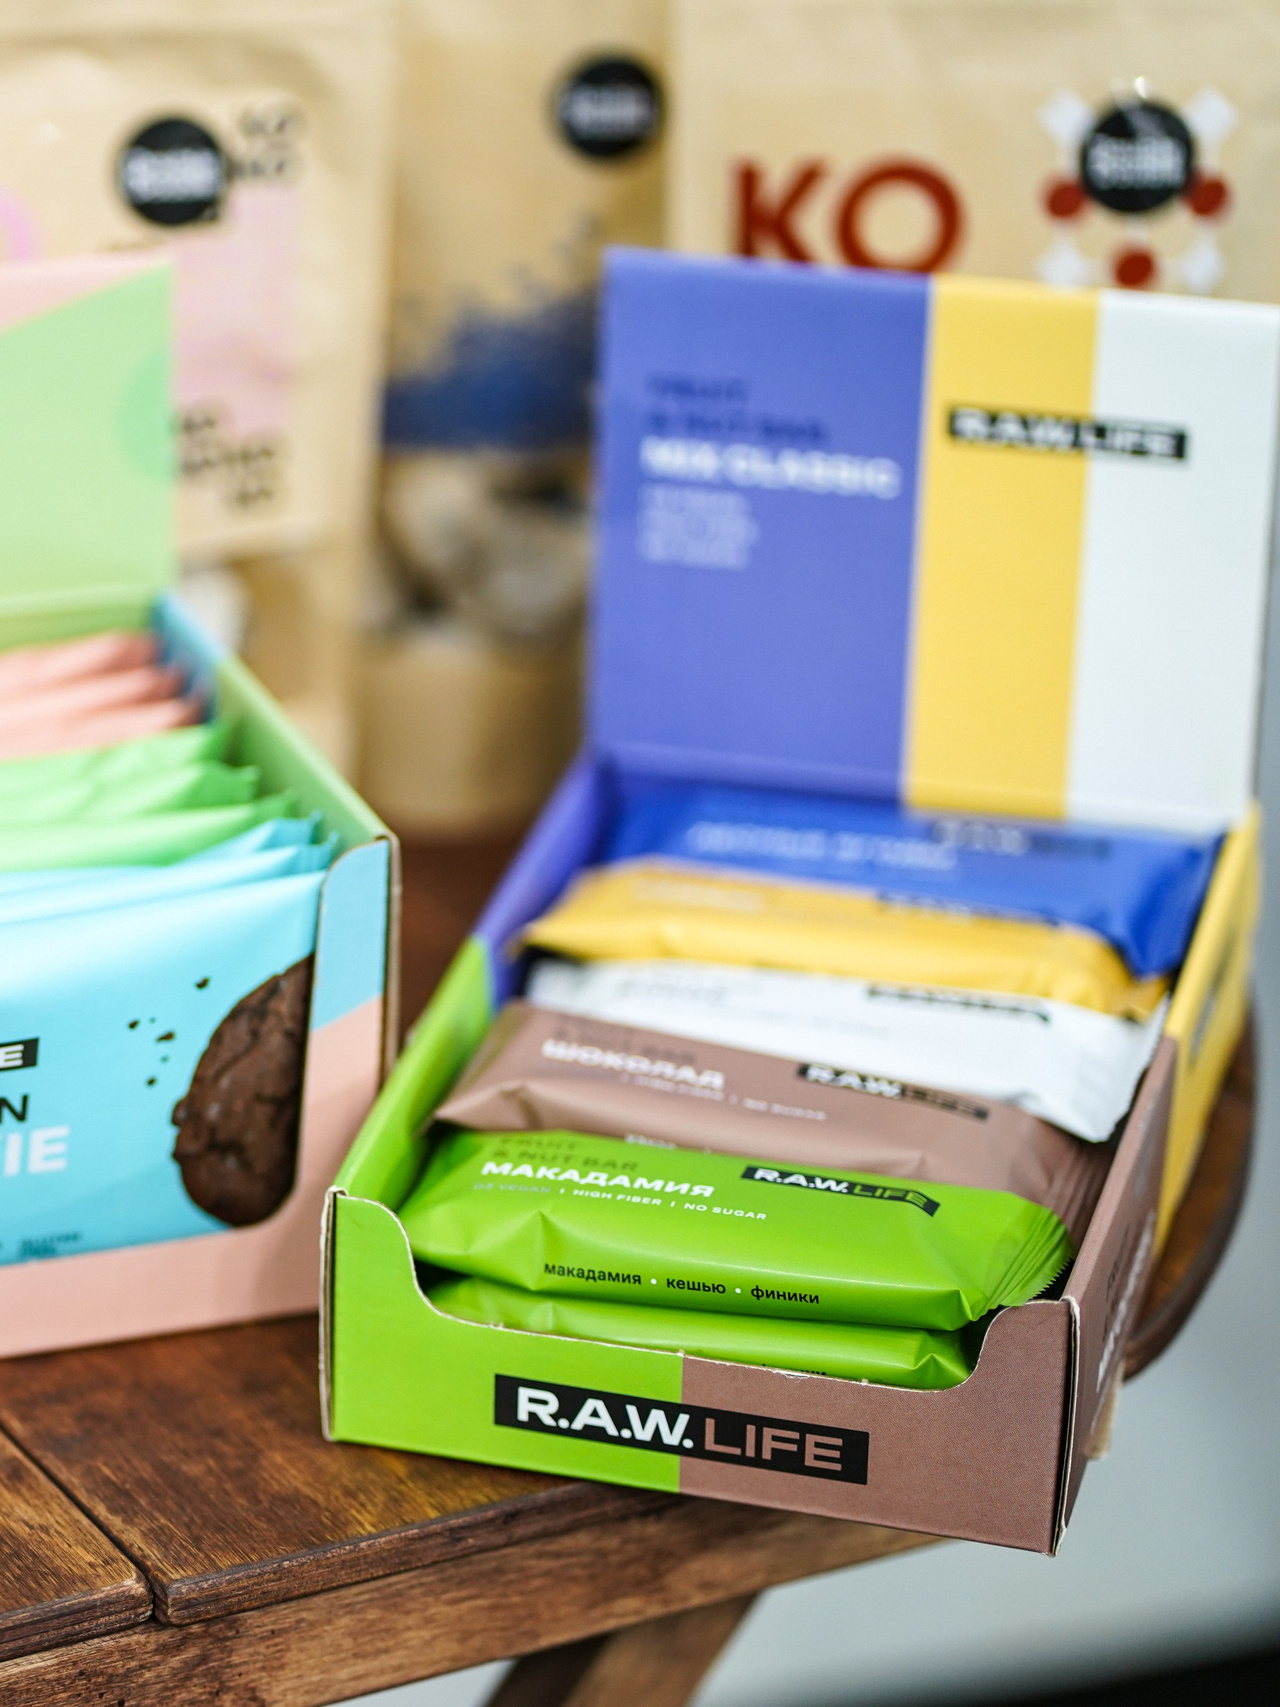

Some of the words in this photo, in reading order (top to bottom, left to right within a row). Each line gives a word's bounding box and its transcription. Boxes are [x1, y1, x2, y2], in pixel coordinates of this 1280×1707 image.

[722, 443, 902, 500] CLASSIC
[542, 1038, 725, 1091] ШОКОЛАД
[481, 1161, 714, 1199] МАКАДАМИЯ
[573, 1188, 613, 1200] HIGH
[616, 1193, 663, 1206] FIBER
[683, 1202, 708, 1212] NO
[711, 1206, 767, 1221] SUGAR
[544, 1262, 642, 1286] макадамия
[666, 1276, 727, 1295] кешью
[750, 1285, 820, 1305] финики
